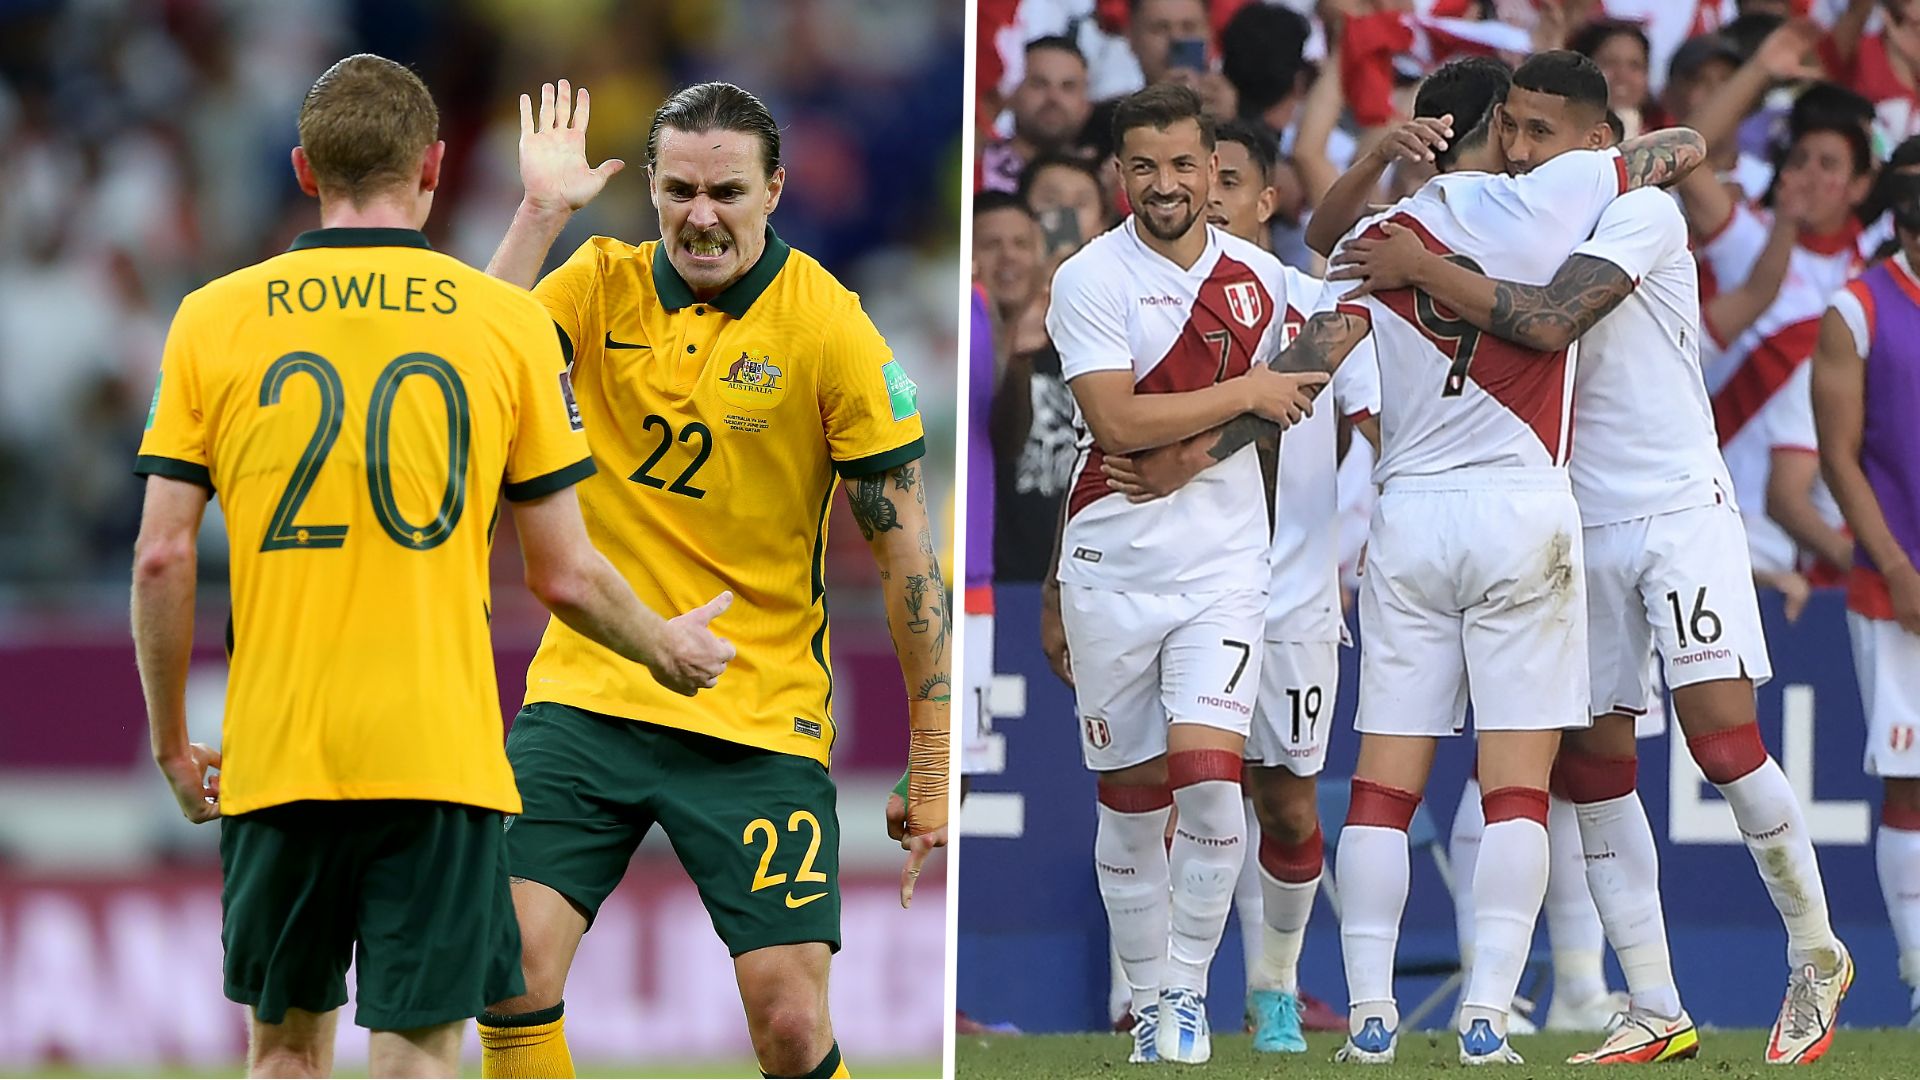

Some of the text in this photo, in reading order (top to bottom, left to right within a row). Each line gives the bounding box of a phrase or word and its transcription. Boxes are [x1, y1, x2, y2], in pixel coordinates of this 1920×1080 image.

[267, 273, 458, 317] ROWLES
[1414, 253, 1486, 398] 9
[1202, 329, 1231, 385] 7
[727, 383, 773, 395] AUSTRALIA
[259, 350, 471, 553] 20
[627, 414, 713, 500] 22
[1666, 586, 1722, 648] 16
[1221, 639, 1250, 694] 7
[1672, 649, 1732, 666] marathon
[1285, 685, 1322, 744] 19
[743, 810, 827, 893] 22
[1177, 829, 1238, 847] marathon
